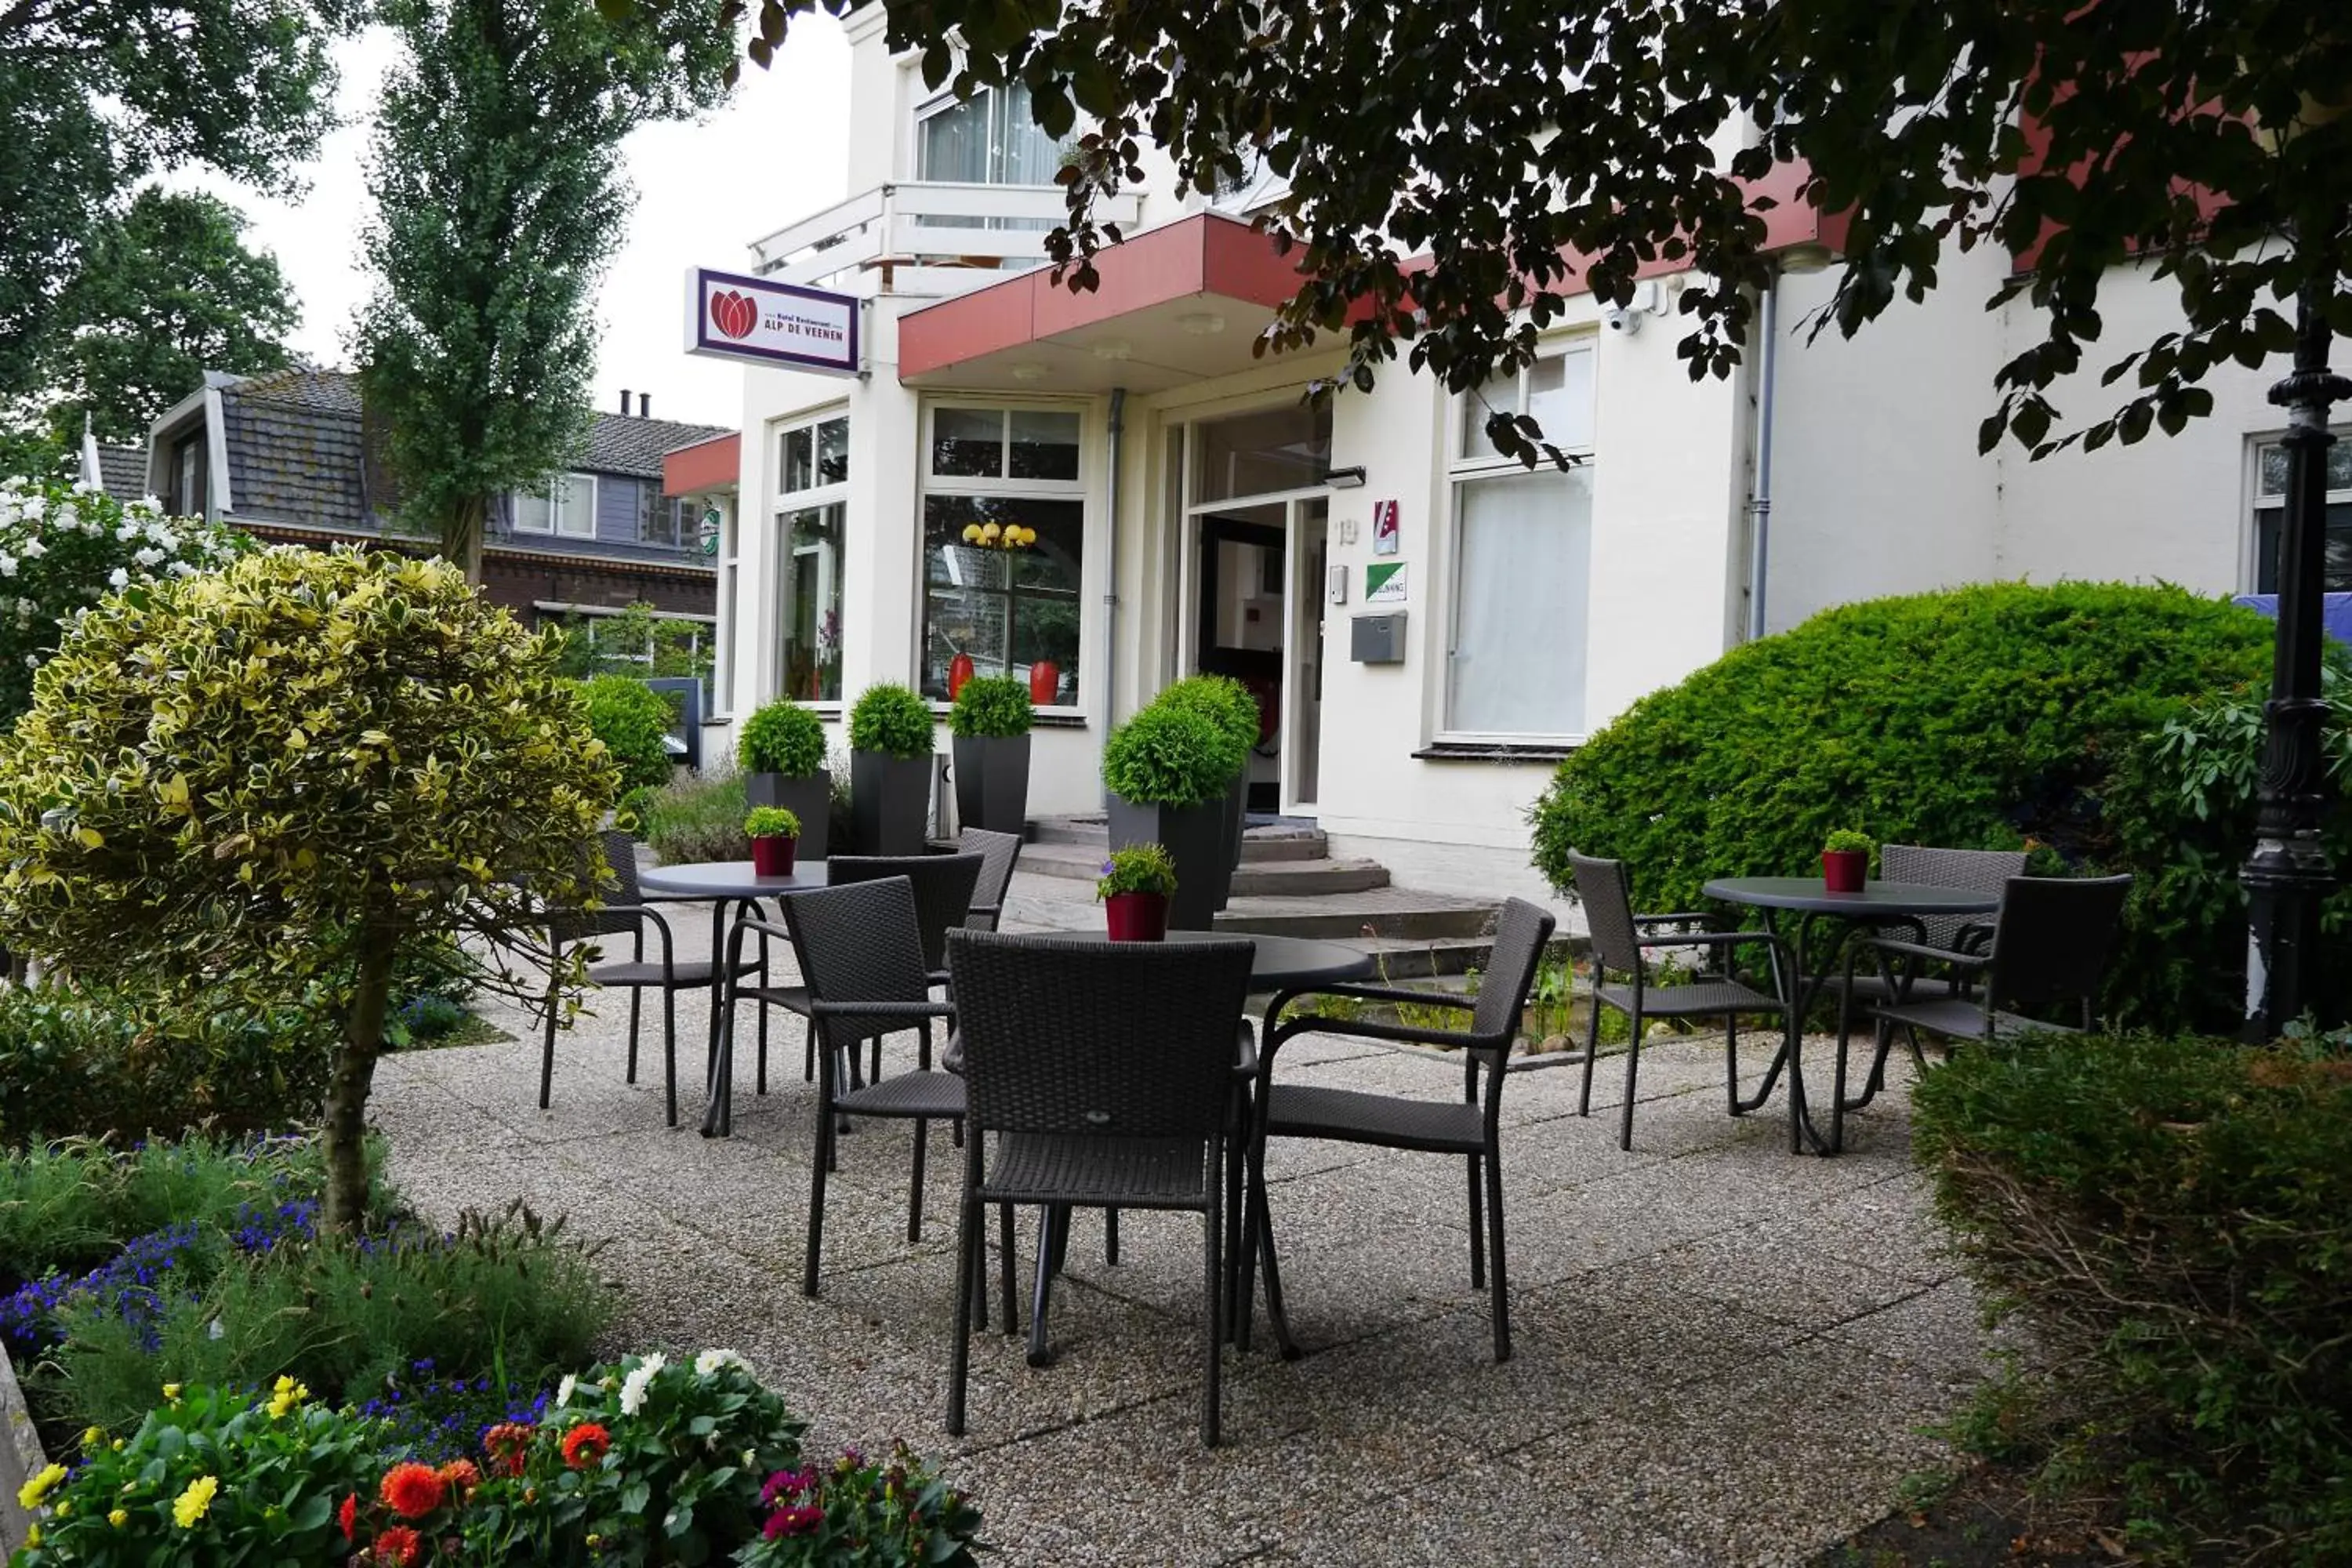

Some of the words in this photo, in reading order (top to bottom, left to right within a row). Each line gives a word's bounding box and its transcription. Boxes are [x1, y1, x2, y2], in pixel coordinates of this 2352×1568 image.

[764, 319, 783, 331] ALP
[788, 323, 800, 335] DE
[805, 326, 843, 341] VEENEN
